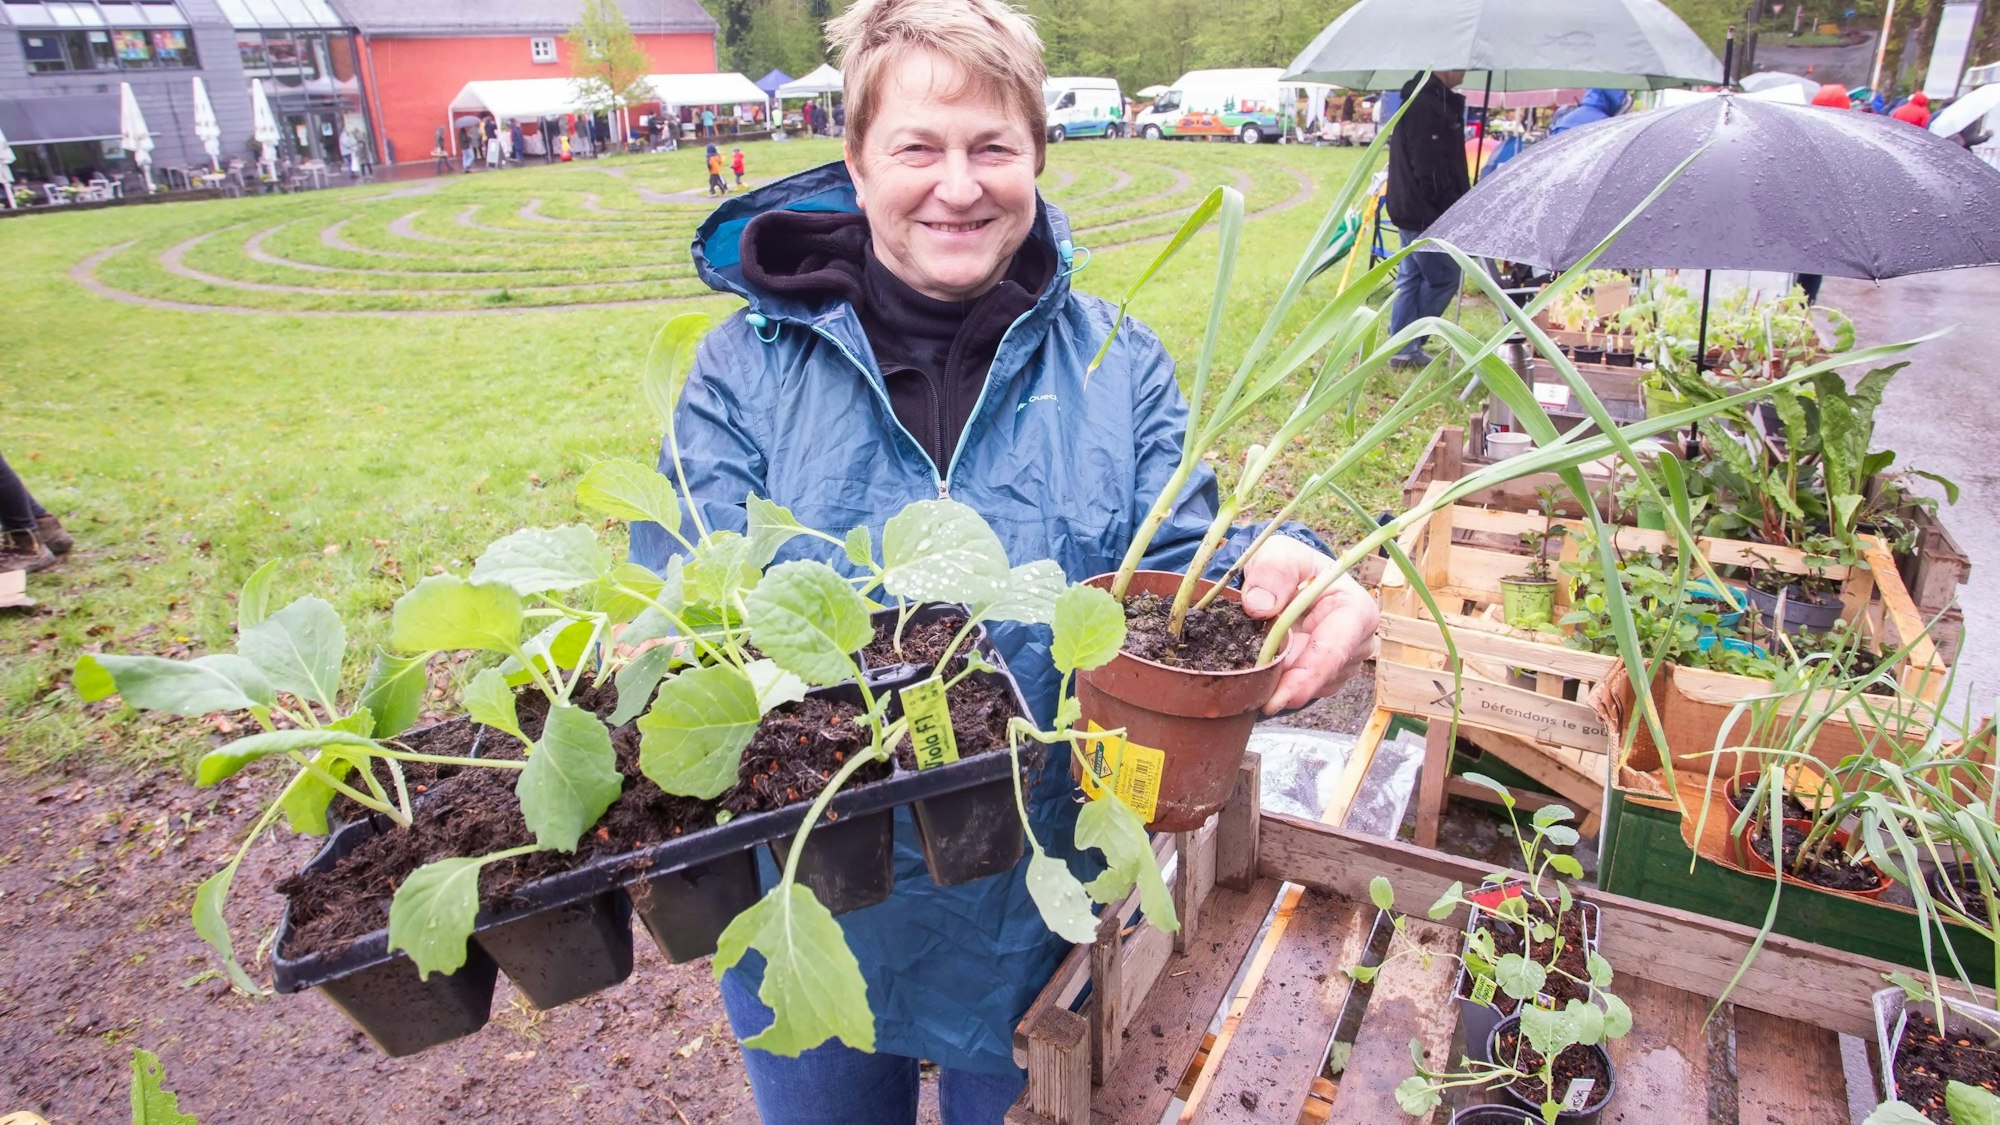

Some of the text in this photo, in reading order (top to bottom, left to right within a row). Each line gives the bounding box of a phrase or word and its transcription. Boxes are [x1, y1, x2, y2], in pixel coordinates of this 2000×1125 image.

[914, 714, 936, 734] F1
[1481, 700, 1557, 726] Défendons
[1563, 719, 1576, 730] le
[919, 733, 945, 769] Viola
